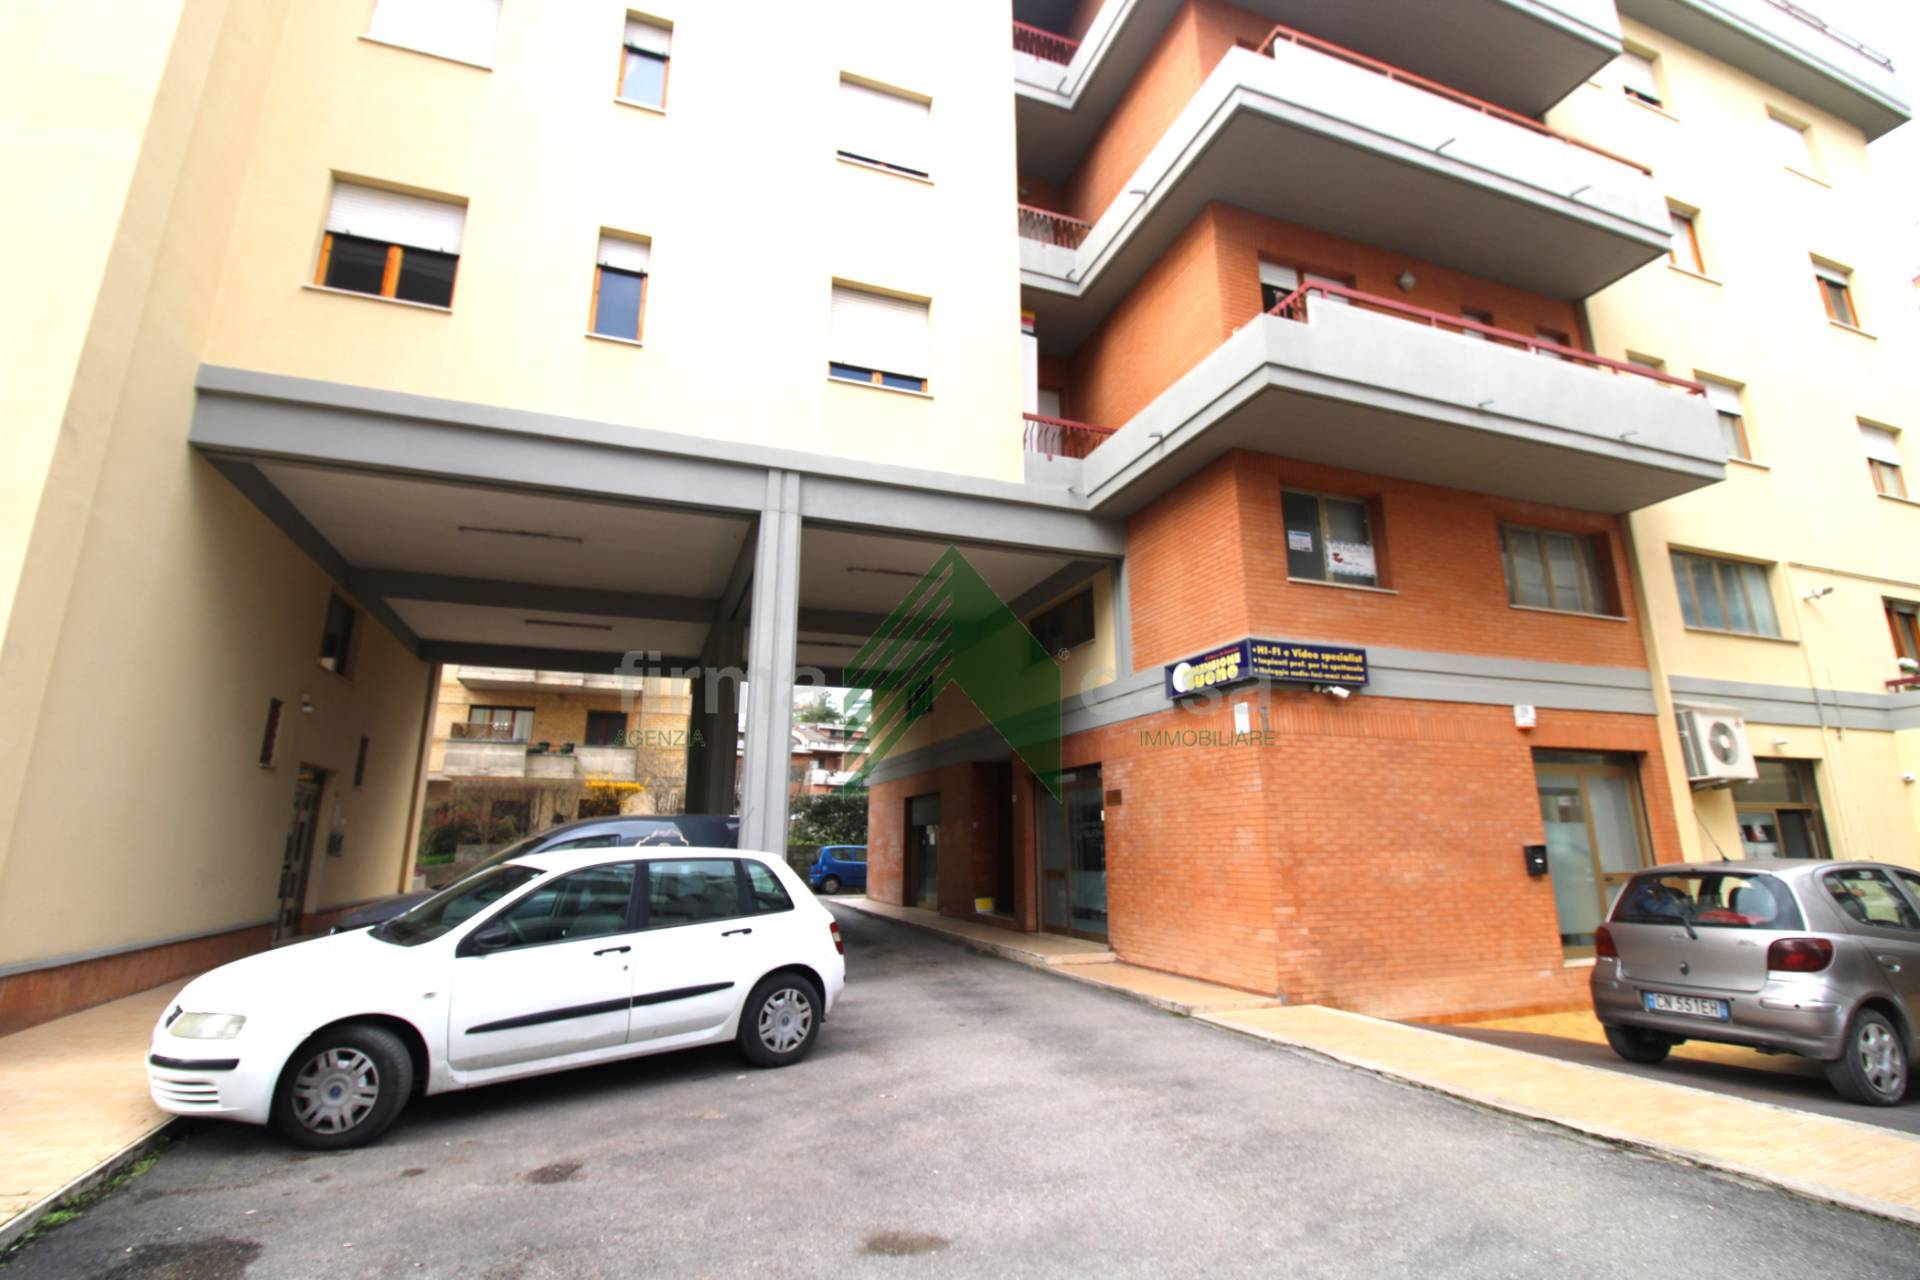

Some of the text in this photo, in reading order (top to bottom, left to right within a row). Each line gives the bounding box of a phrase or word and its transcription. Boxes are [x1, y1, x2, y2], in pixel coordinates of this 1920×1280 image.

[1291, 648, 1319, 659] Video
[1321, 652, 1363, 663] specialist
[1676, 996, 1718, 1015] 551EH
